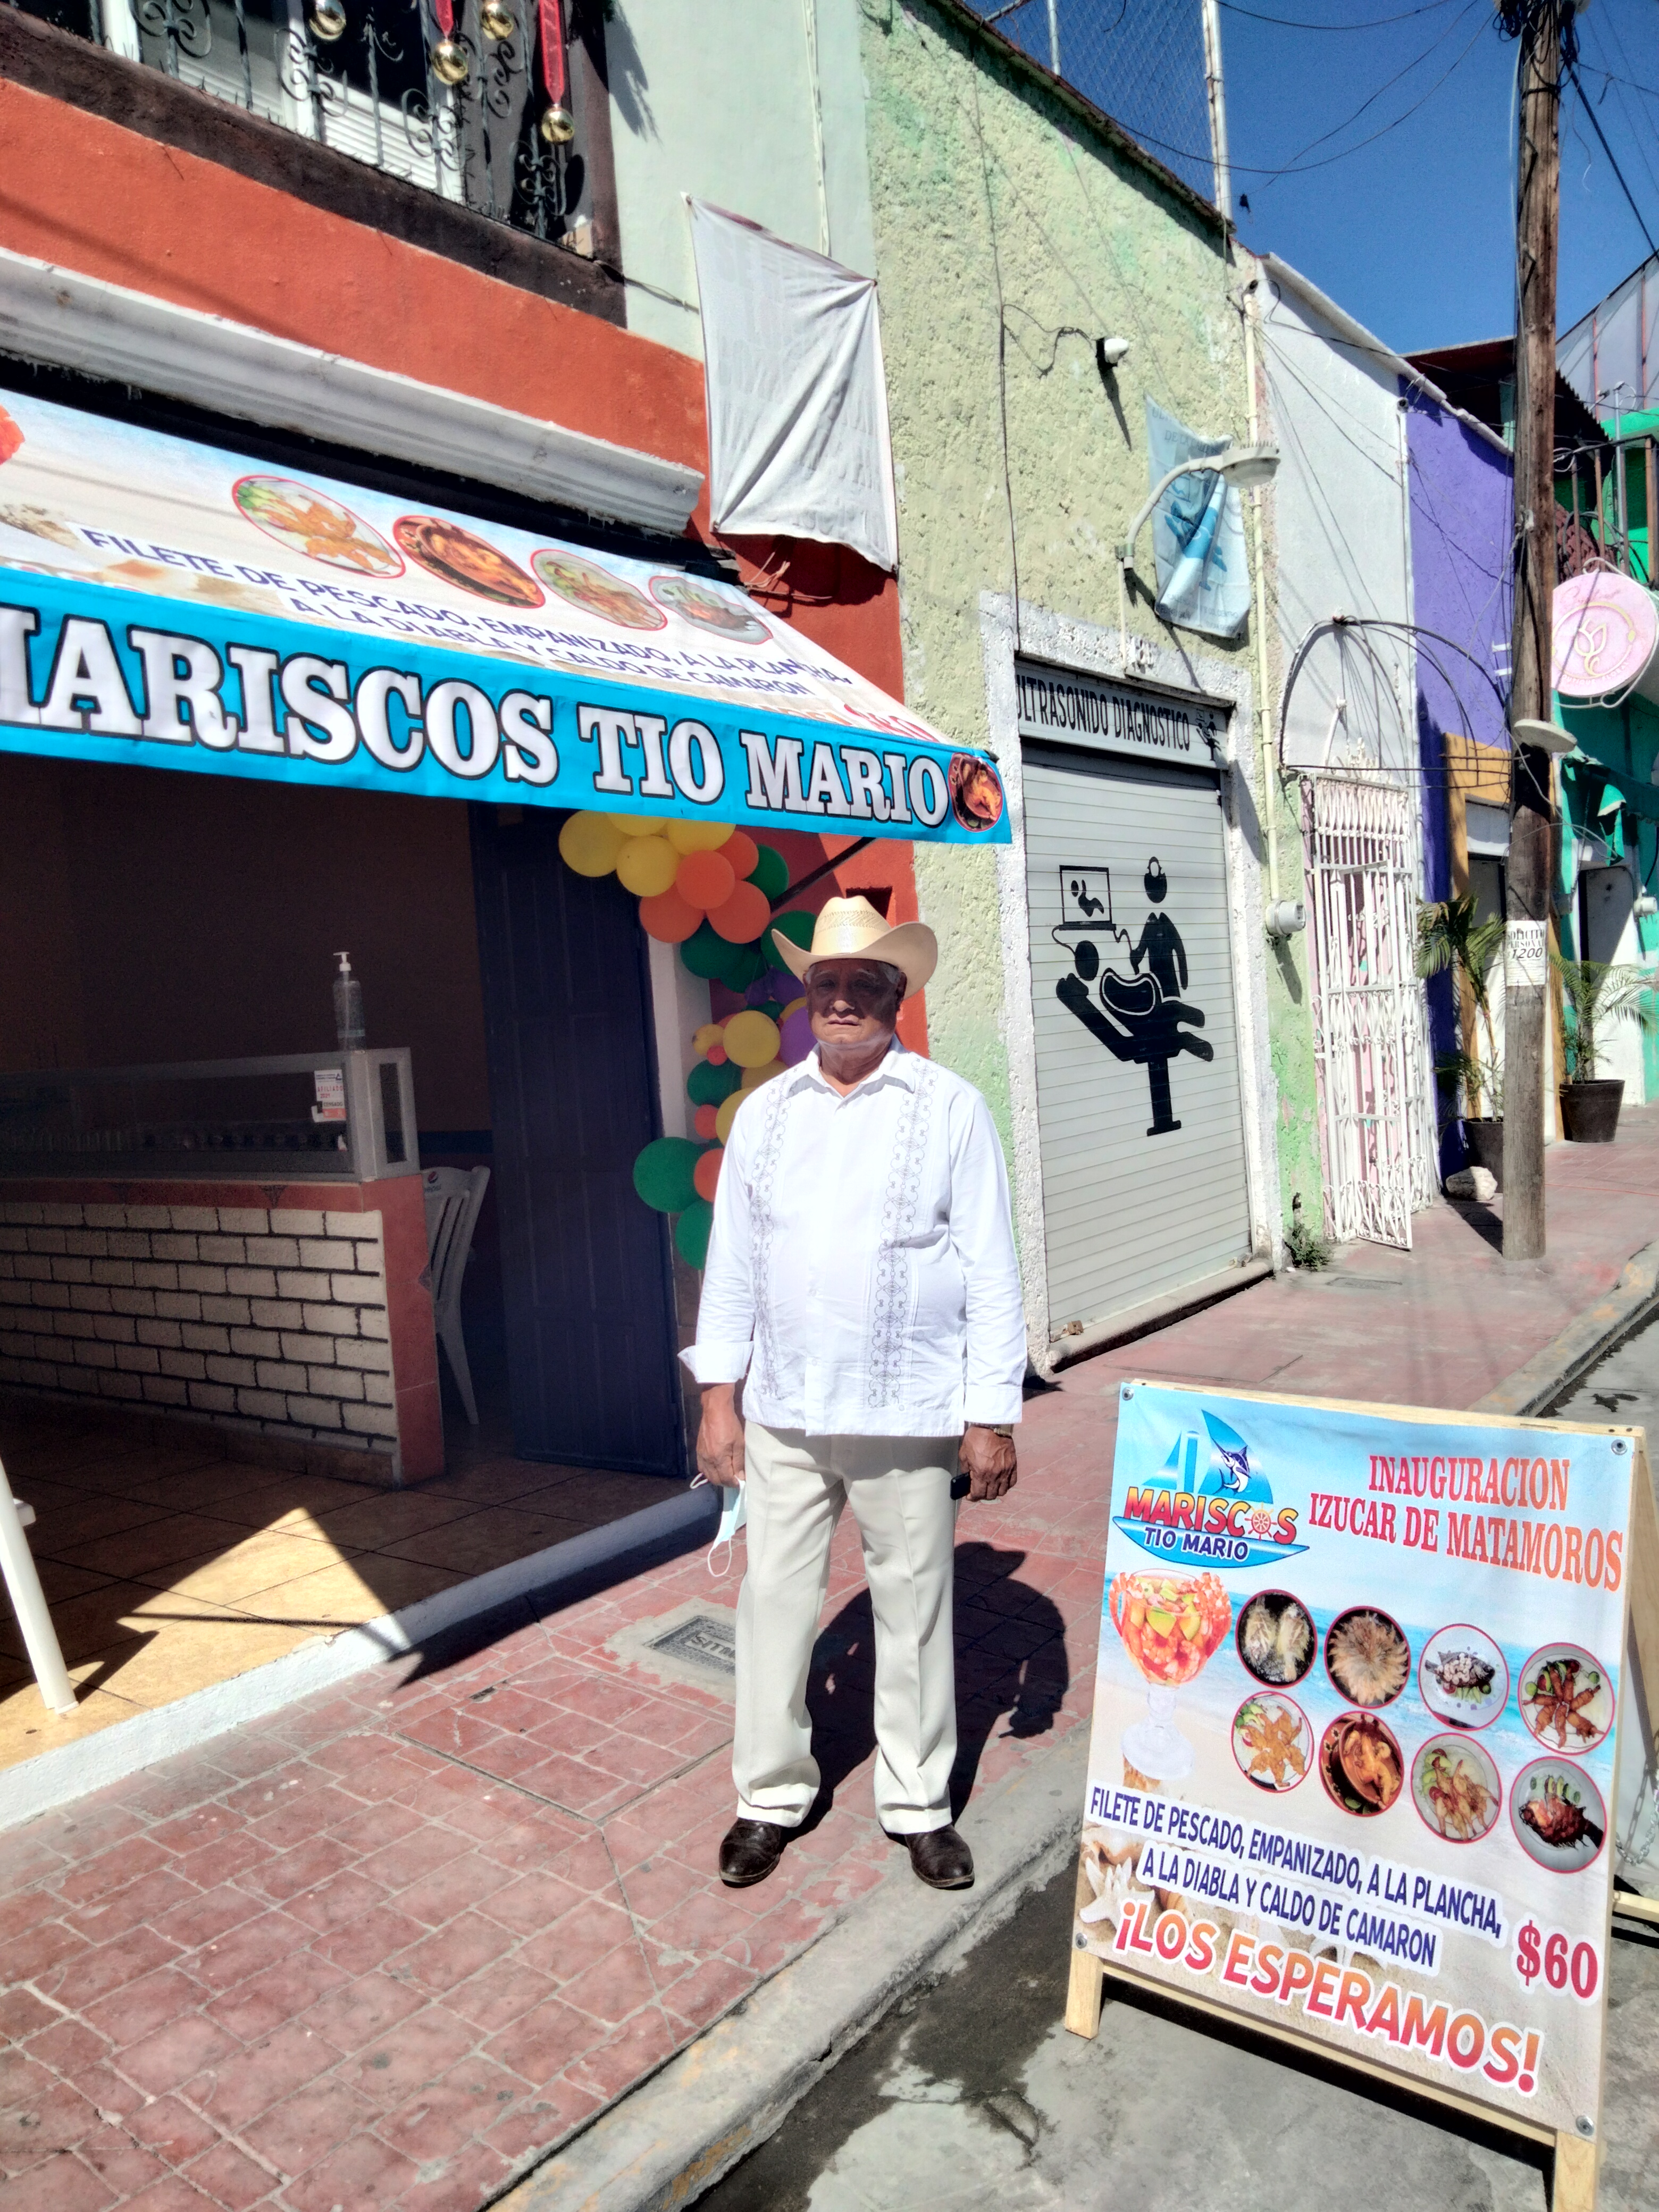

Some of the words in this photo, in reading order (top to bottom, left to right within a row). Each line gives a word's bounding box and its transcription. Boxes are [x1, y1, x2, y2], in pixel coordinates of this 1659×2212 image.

[80, 528, 234, 578] FILETE
[234, 564, 298, 591] DE
[296, 578, 483, 630] PESCADO,
[476, 616, 682, 666] EMPANIZADO,
[678, 650, 706, 667] A
[697, 653, 743, 671] LA
[734, 657, 853, 685] PLANHA,
[289, 597, 325, 616] A
[321, 604, 384, 628] LA
[381, 616, 522, 652] DIABLA
[513, 641, 544, 656] Y
[545, 647, 648, 675] CALDO
[642, 665, 692, 683] DE
[686, 671, 817, 696] CAMARON
[578, 702, 724, 805] TIO
[740, 730, 949, 828] MARIO
[1112, 696, 1191, 752] DIAGNOSTICO
[1368, 1455, 1570, 1511] INAUGURACION
[1144, 1527, 1177, 1548] TIO
[1182, 1535, 1249, 1560] MARIO
[1309, 1492, 1397, 1544] IZUCAR
[1403, 1505, 1439, 1553] DE
[1446, 1511, 1623, 1593] MATAMOROS
[1090, 1786, 1142, 1826] FILETE
[1143, 1799, 1166, 1833] DE
[1168, 1806, 1245, 1859] PESCADO,
[1248, 1828, 1363, 1895] EMPANIZADO,
[1367, 1863, 1380, 1897] A
[1384, 1867, 1407, 1906] LA
[1412, 1875, 1502, 1939] PLANCHA,
[1142, 1848, 1155, 1878] A
[1158, 1851, 1179, 1885] LA
[1183, 1858, 1239, 1905] DIABLA
[1245, 1878, 1258, 1908] Y
[1260, 1881, 1316, 1926] CALDO
[1318, 1899, 1344, 1936] DE
[1346, 1907, 1437, 1968] CAMARON
[1516, 1920, 1598, 1999] $60
[1222, 1932, 1540, 2093] ESPERAMOS!
